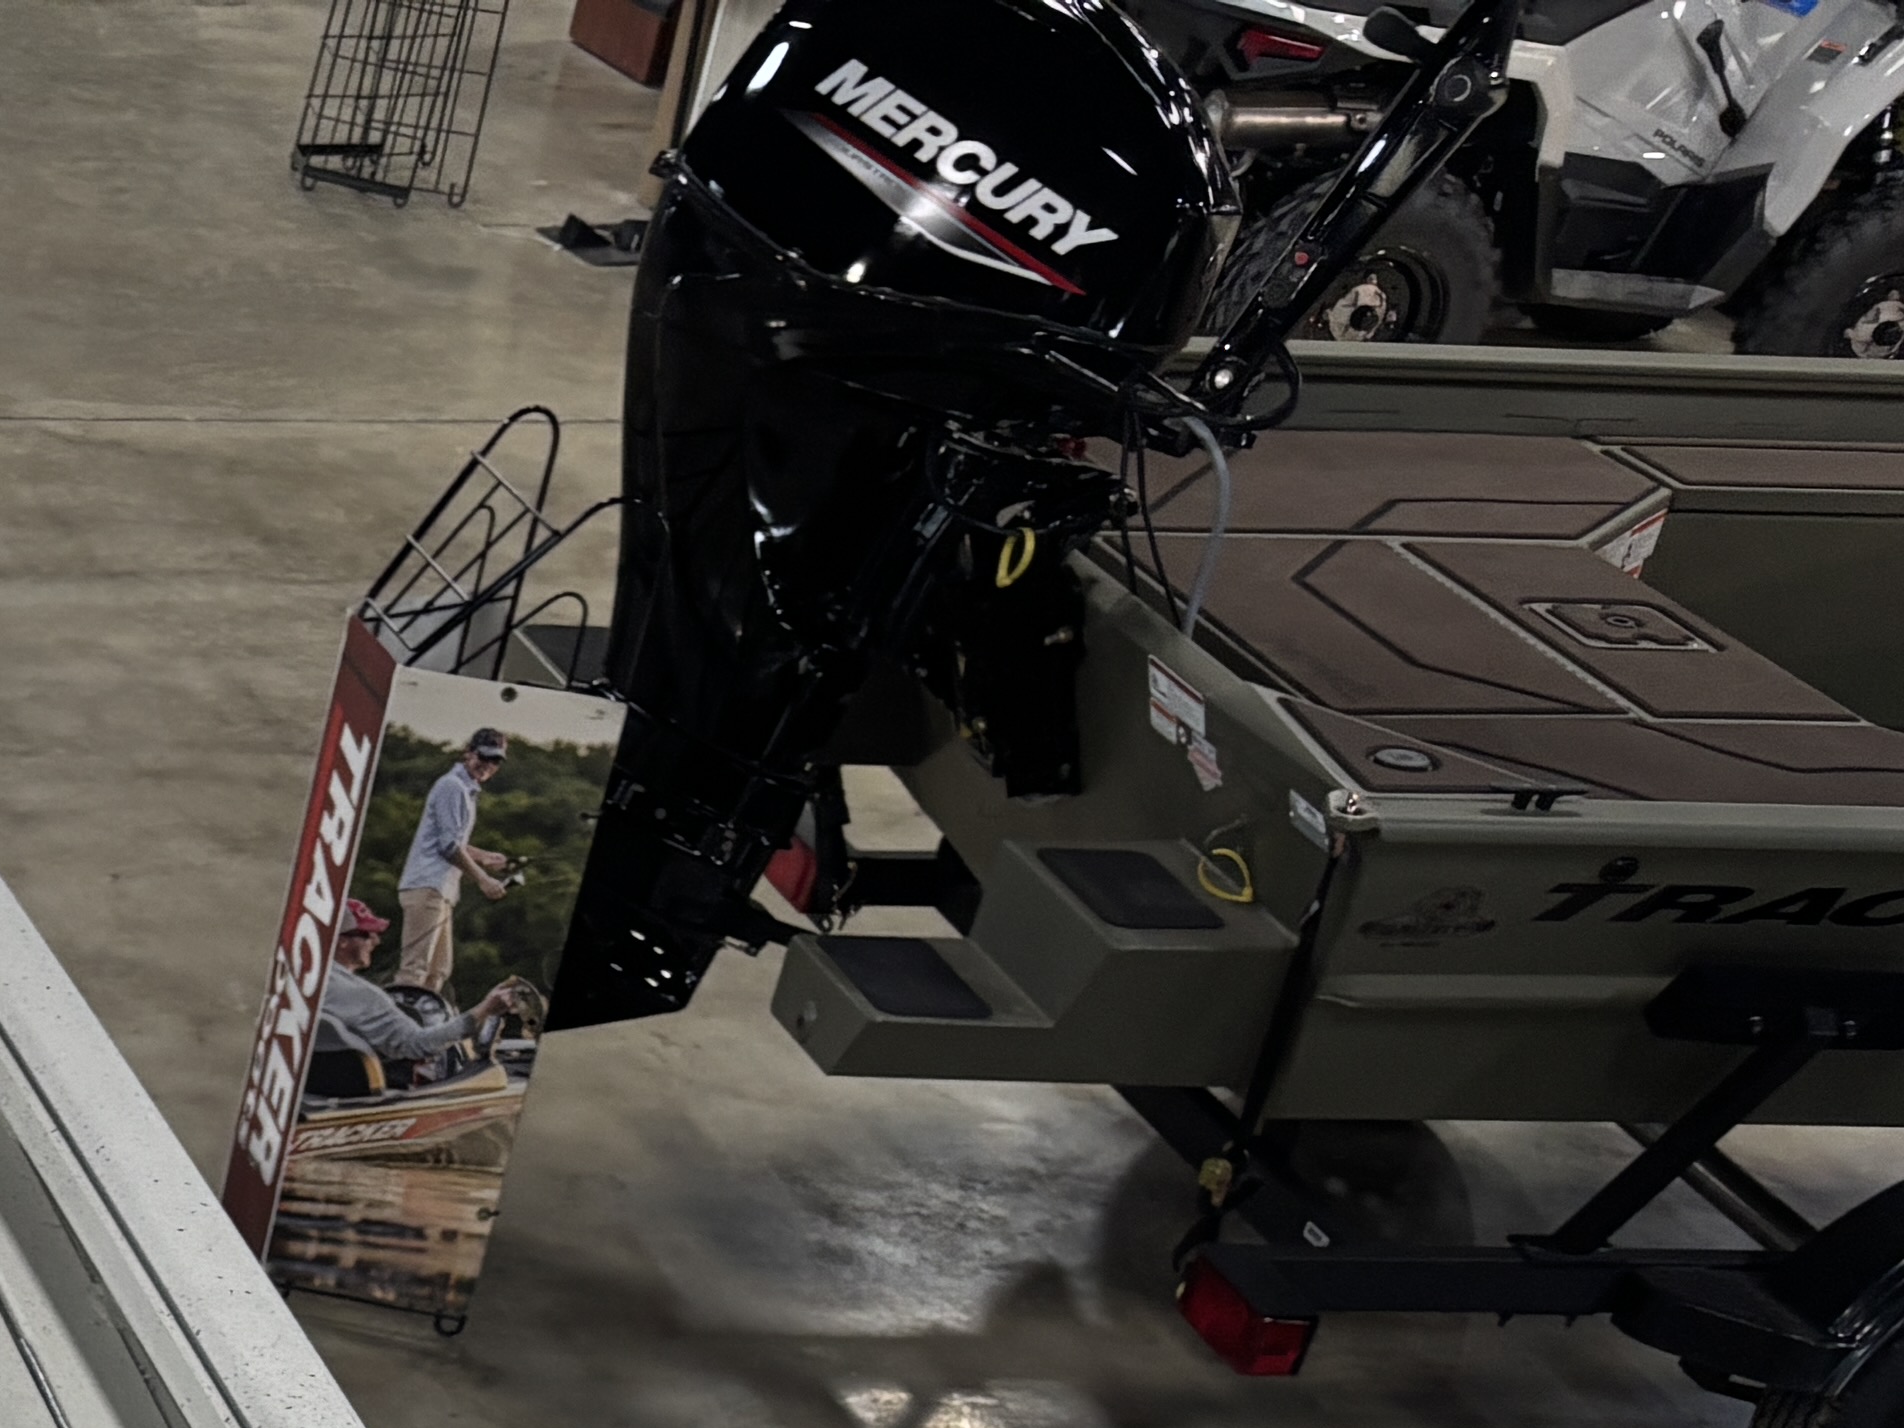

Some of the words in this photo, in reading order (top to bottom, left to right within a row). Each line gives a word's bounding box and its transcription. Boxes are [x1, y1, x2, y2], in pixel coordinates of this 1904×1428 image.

[813, 58, 1120, 256] MERCURY
[1652, 128, 1706, 168] POLARIS
[248, 722, 371, 1187] TRACKER
